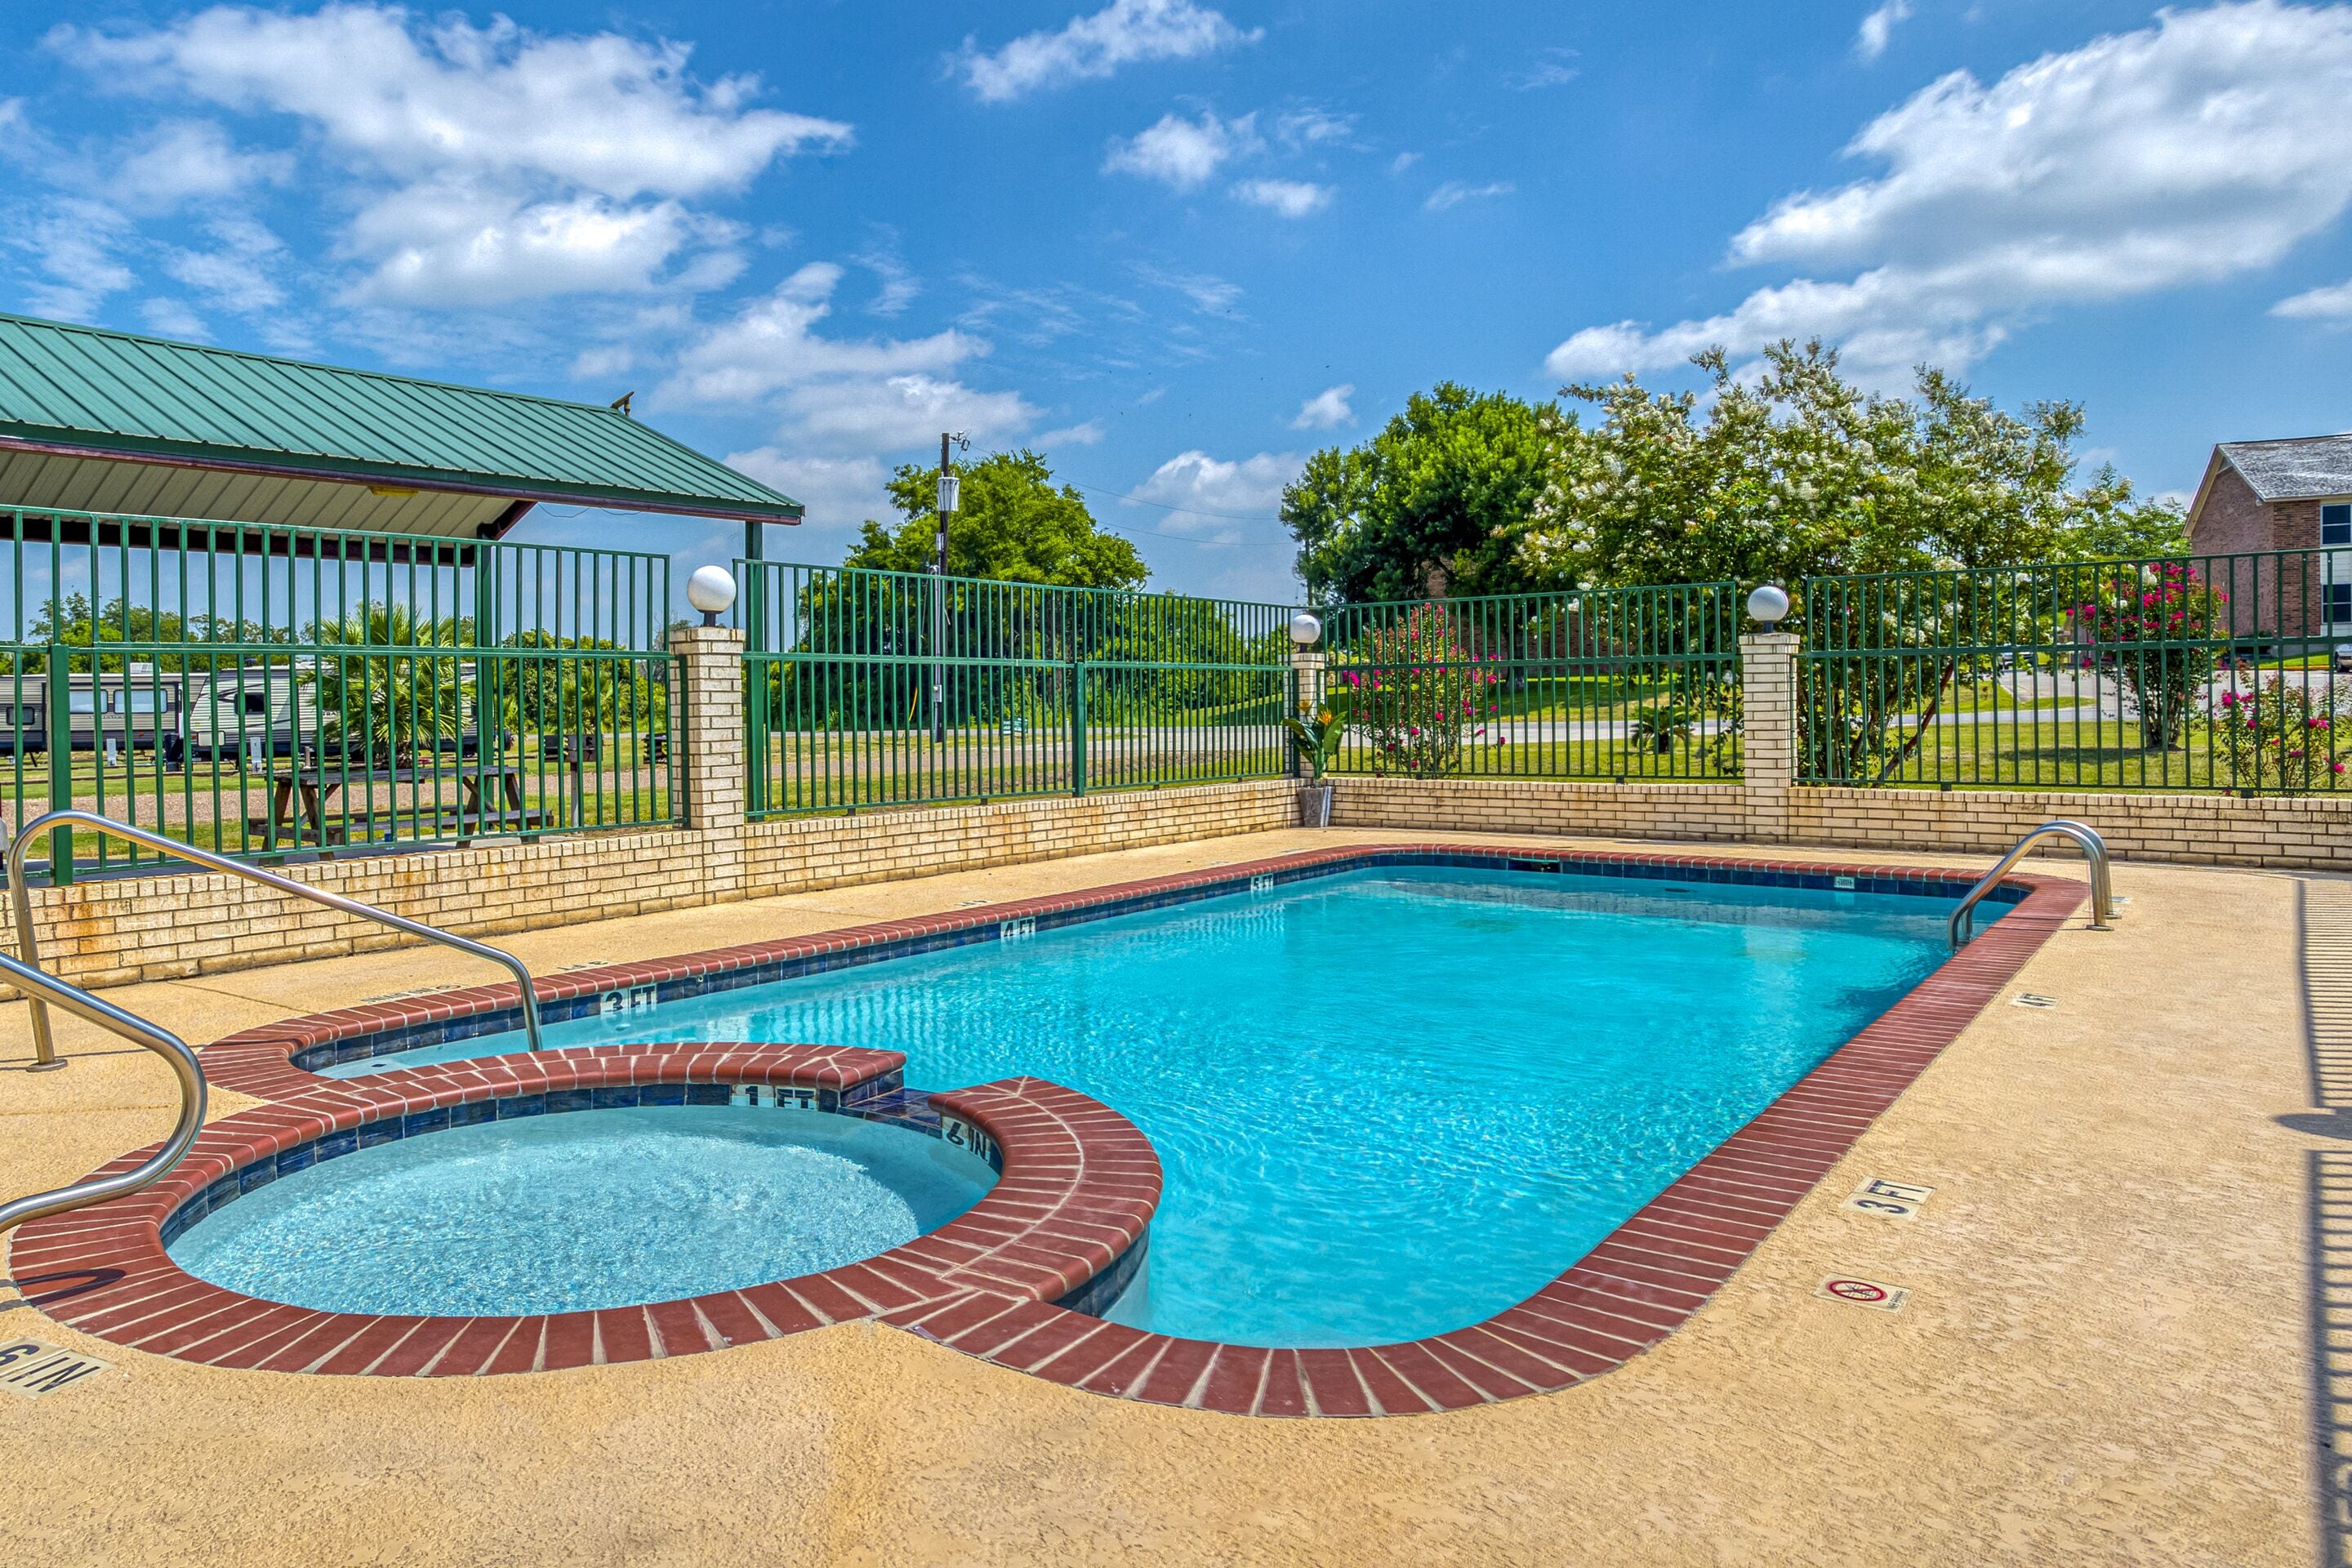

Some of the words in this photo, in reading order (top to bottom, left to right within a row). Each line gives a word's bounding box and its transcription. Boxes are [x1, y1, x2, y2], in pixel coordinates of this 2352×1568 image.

[1004, 922, 1014, 937] 4
[1019, 918, 1034, 935] FT
[605, 991, 624, 1013] 3
[630, 985, 656, 1008] FT
[745, 1085, 759, 1107] 1
[777, 1088, 815, 1110] FT
[947, 1121, 964, 1146] 6
[969, 1129, 988, 1162] IN
[1864, 1179, 1926, 1202] FT
[1854, 1198, 1909, 1214] 3
[7, 1356, 100, 1392] IN
